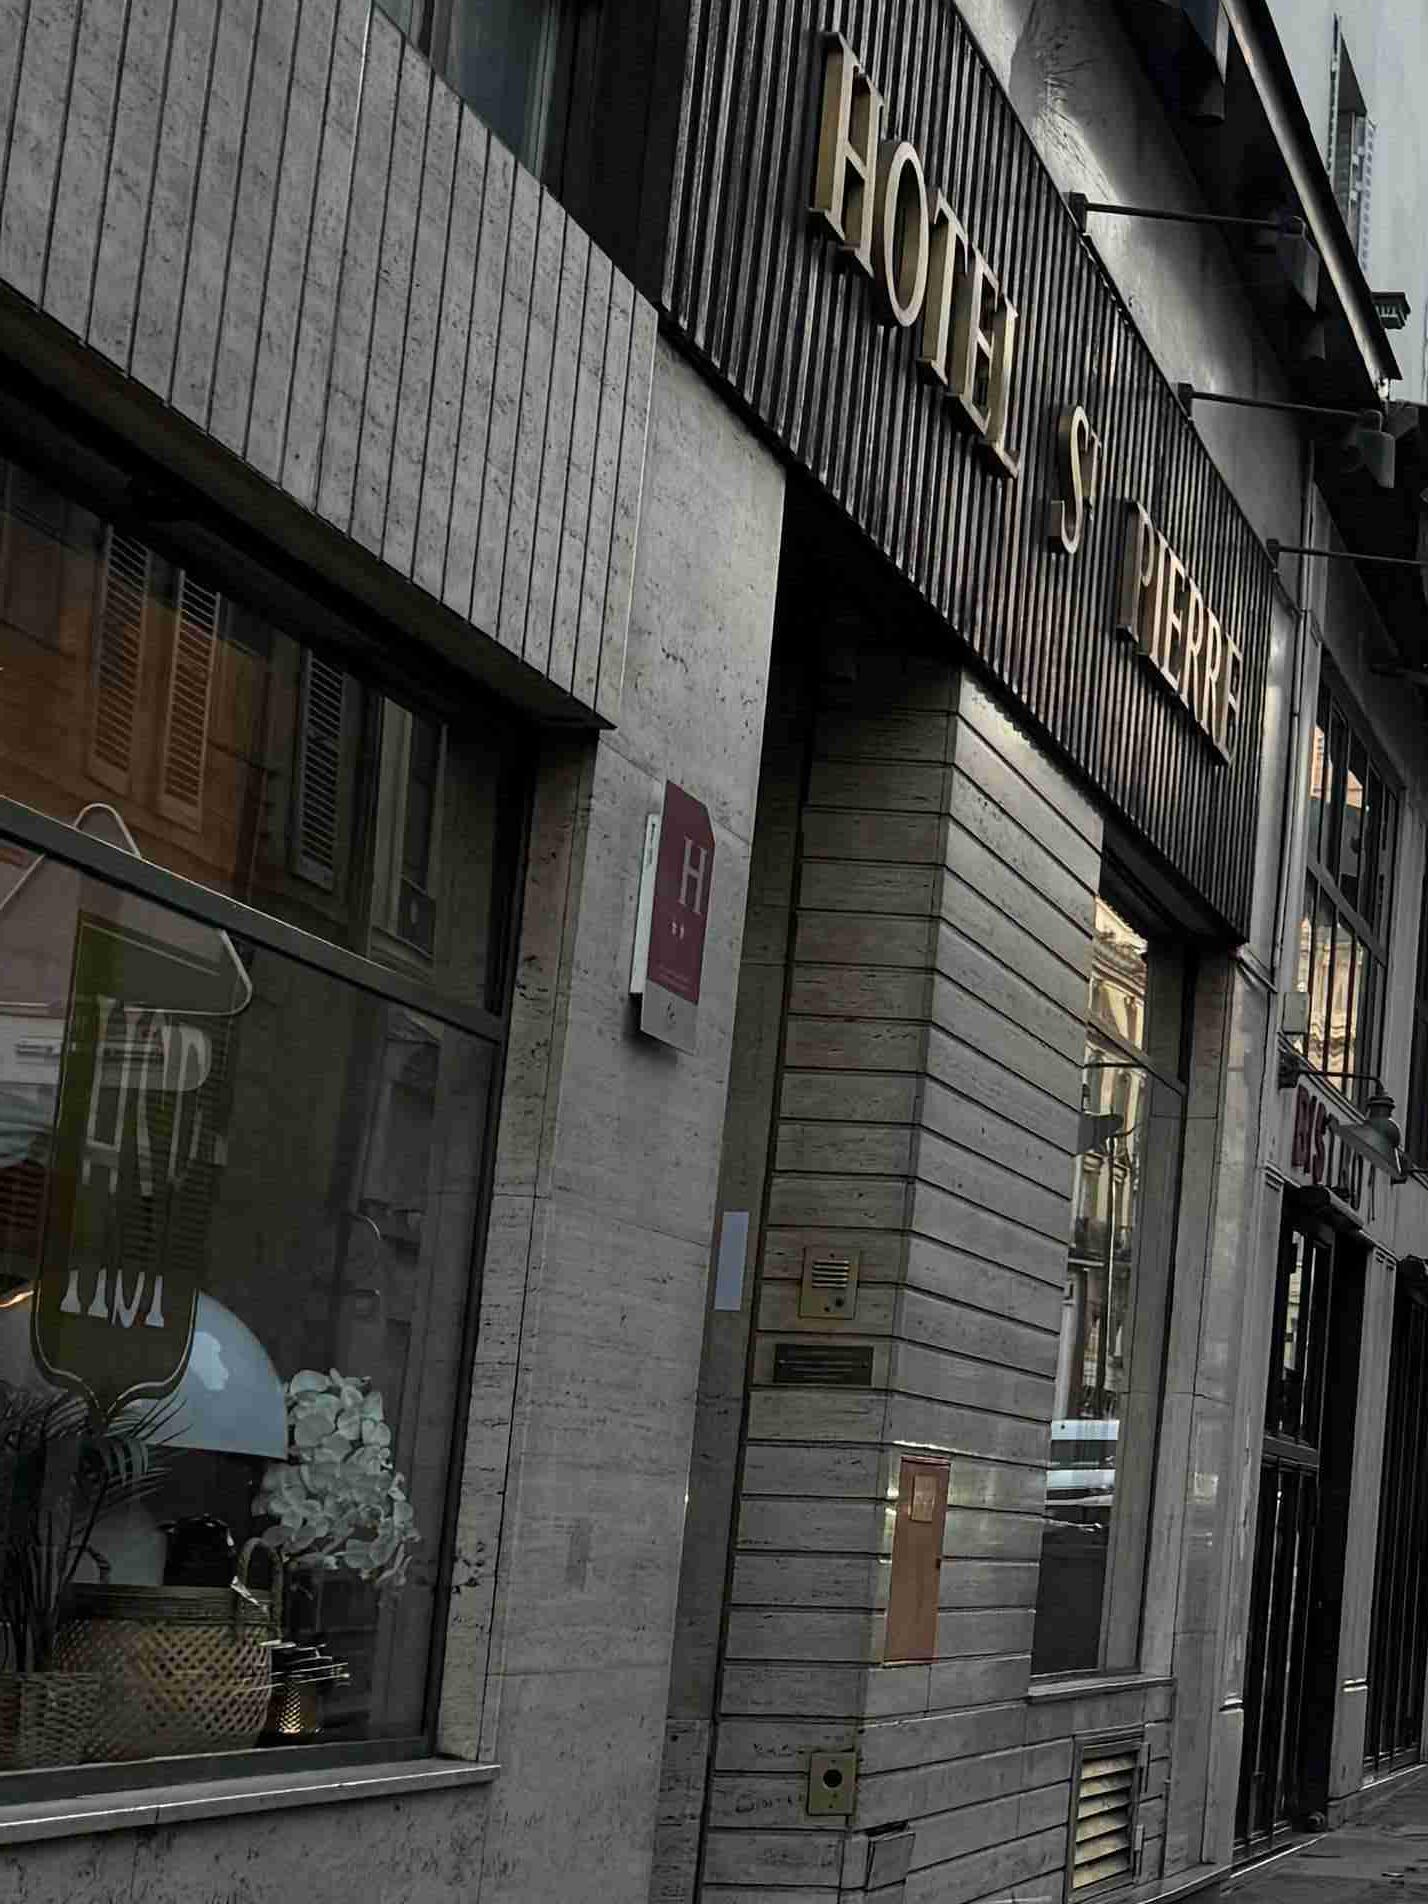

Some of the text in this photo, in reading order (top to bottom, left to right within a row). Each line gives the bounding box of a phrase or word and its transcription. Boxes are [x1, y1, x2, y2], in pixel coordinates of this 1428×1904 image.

[808, 30, 1020, 478] HOTEL
[1118, 500, 1246, 766] PIERRE
[678, 831, 709, 916] H
